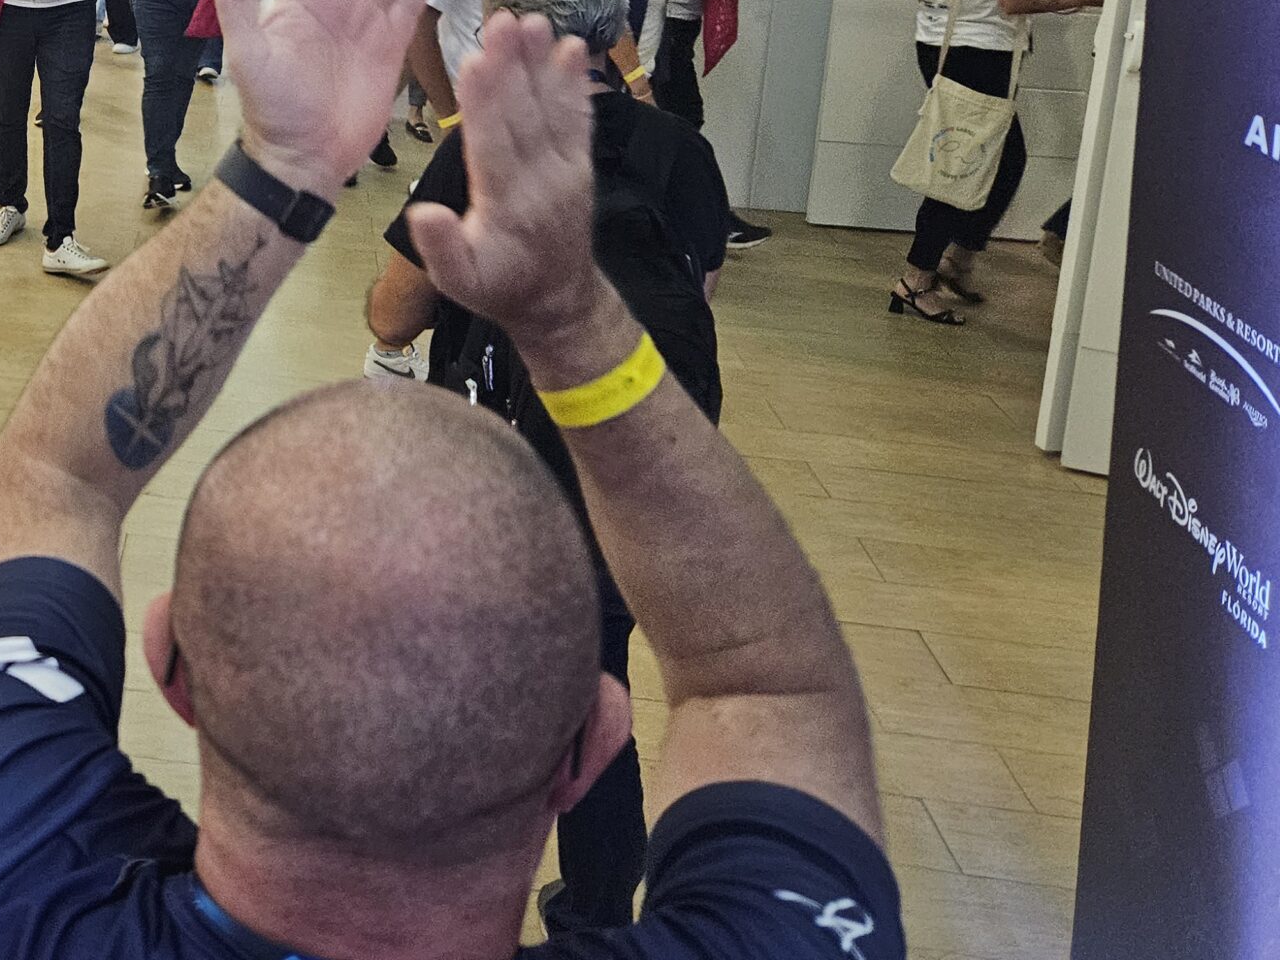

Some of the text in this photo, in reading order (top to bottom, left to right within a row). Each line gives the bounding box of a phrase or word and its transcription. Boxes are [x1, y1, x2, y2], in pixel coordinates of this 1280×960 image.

[1154, 260, 1192, 298] UNITED
[1192, 288, 1226, 323] PARKS
[1226, 312, 1235, 332] &
[1225, 540, 1271, 611] World
[1221, 590, 1267, 649] FLÓRIDA
